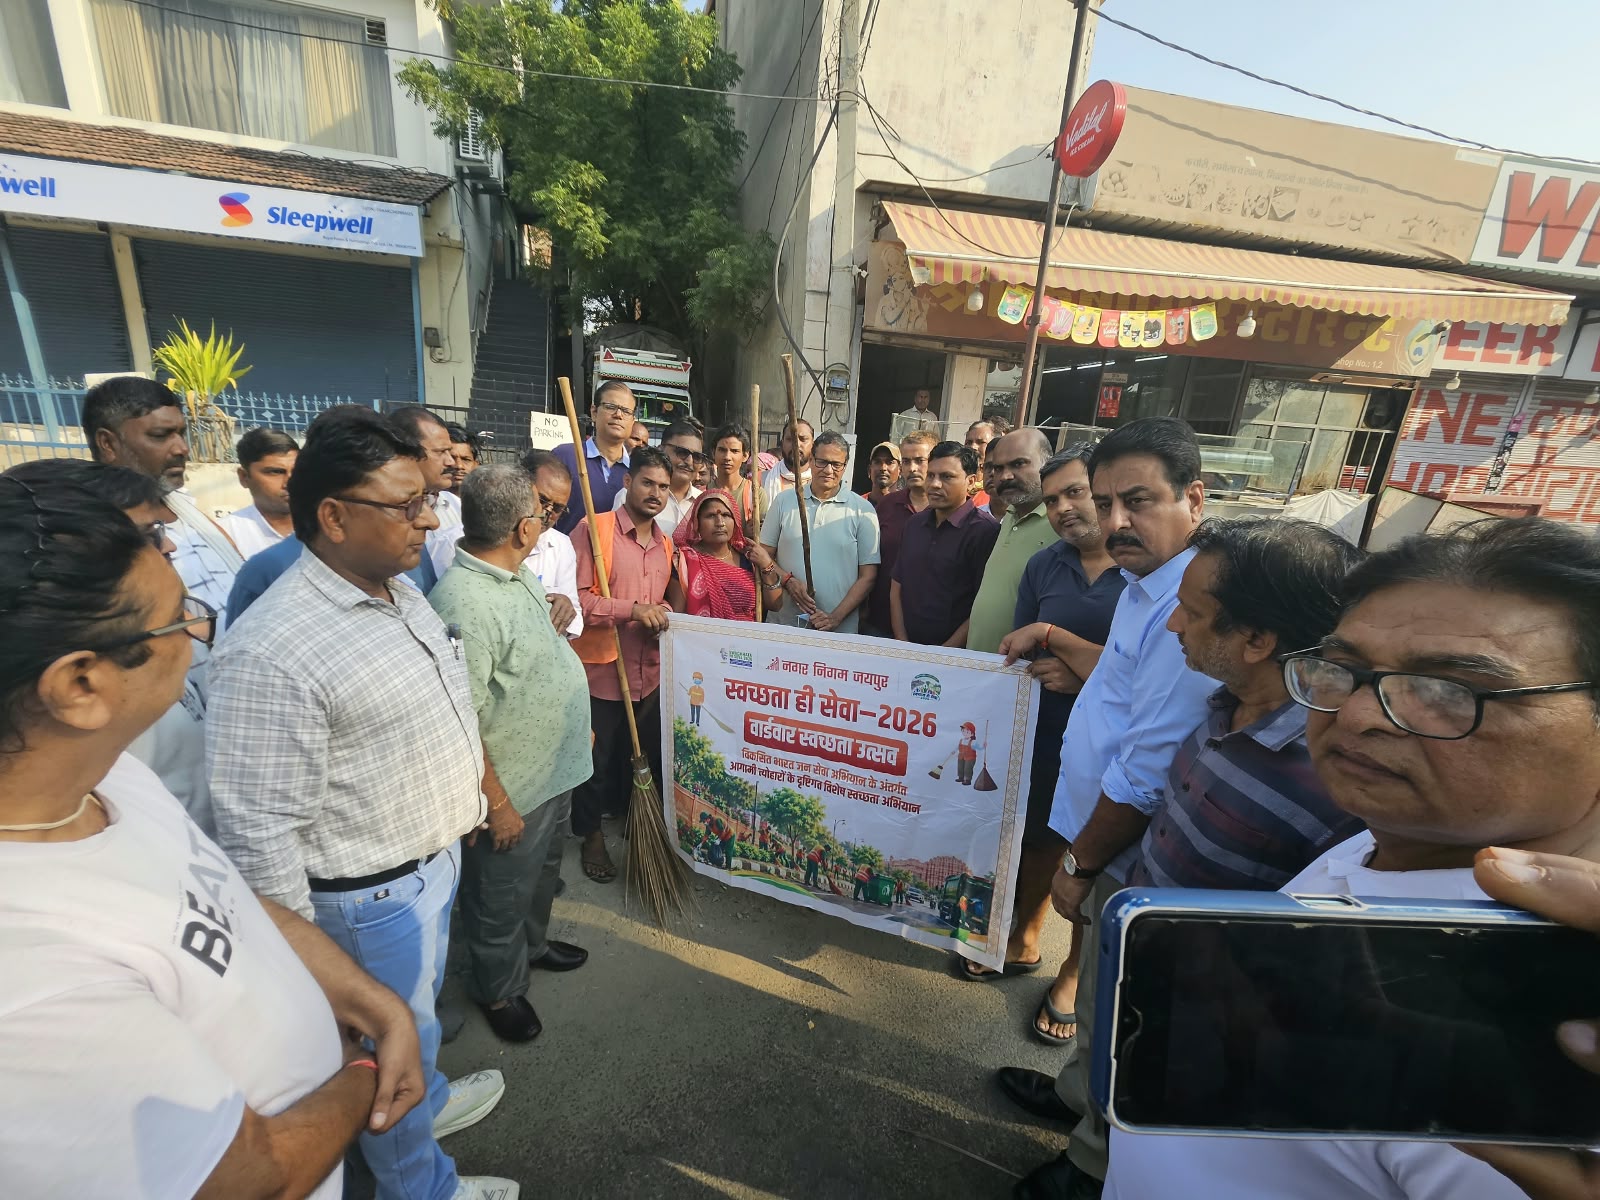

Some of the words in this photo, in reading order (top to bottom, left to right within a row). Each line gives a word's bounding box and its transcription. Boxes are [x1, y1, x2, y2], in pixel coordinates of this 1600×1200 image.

[1069, 146, 1078, 157] ICE
[1077, 135, 1095, 152] CREAM
[0, 176, 56, 198] well
[267, 206, 373, 235] Sleepwell
[1438, 320, 1561, 367] EER
[534, 426, 564, 440] PARKING
[544, 417, 559, 428] NO
[1399, 388, 1509, 446] INE
[782, 660, 808, 677] नगर
[813, 661, 848, 682] निगम
[853, 671, 889, 691] जयपुर
[723, 677, 791, 710] स्वच्छता
[794, 684, 817, 714] ही
[749, 717, 797, 745] वार्डवार
[797, 726, 855, 756] स्वच्छता
[856, 738, 900, 767] उत्सव
[730, 761, 757, 776] आगामी
[786, 773, 795, 784] के
[823, 781, 846, 797] विशेष
[847, 788, 880, 805] स्वच्छता
[881, 795, 921, 815] अभियान
[741, 747, 773, 765] विकसित
[774, 755, 795, 770] भारत
[796, 760, 811, 773] जन
[813, 762, 830, 777] सेवा
[831, 768, 866, 787] अभियान
[867, 776, 878, 789] के
[879, 780, 908, 796] अंतर्गत
